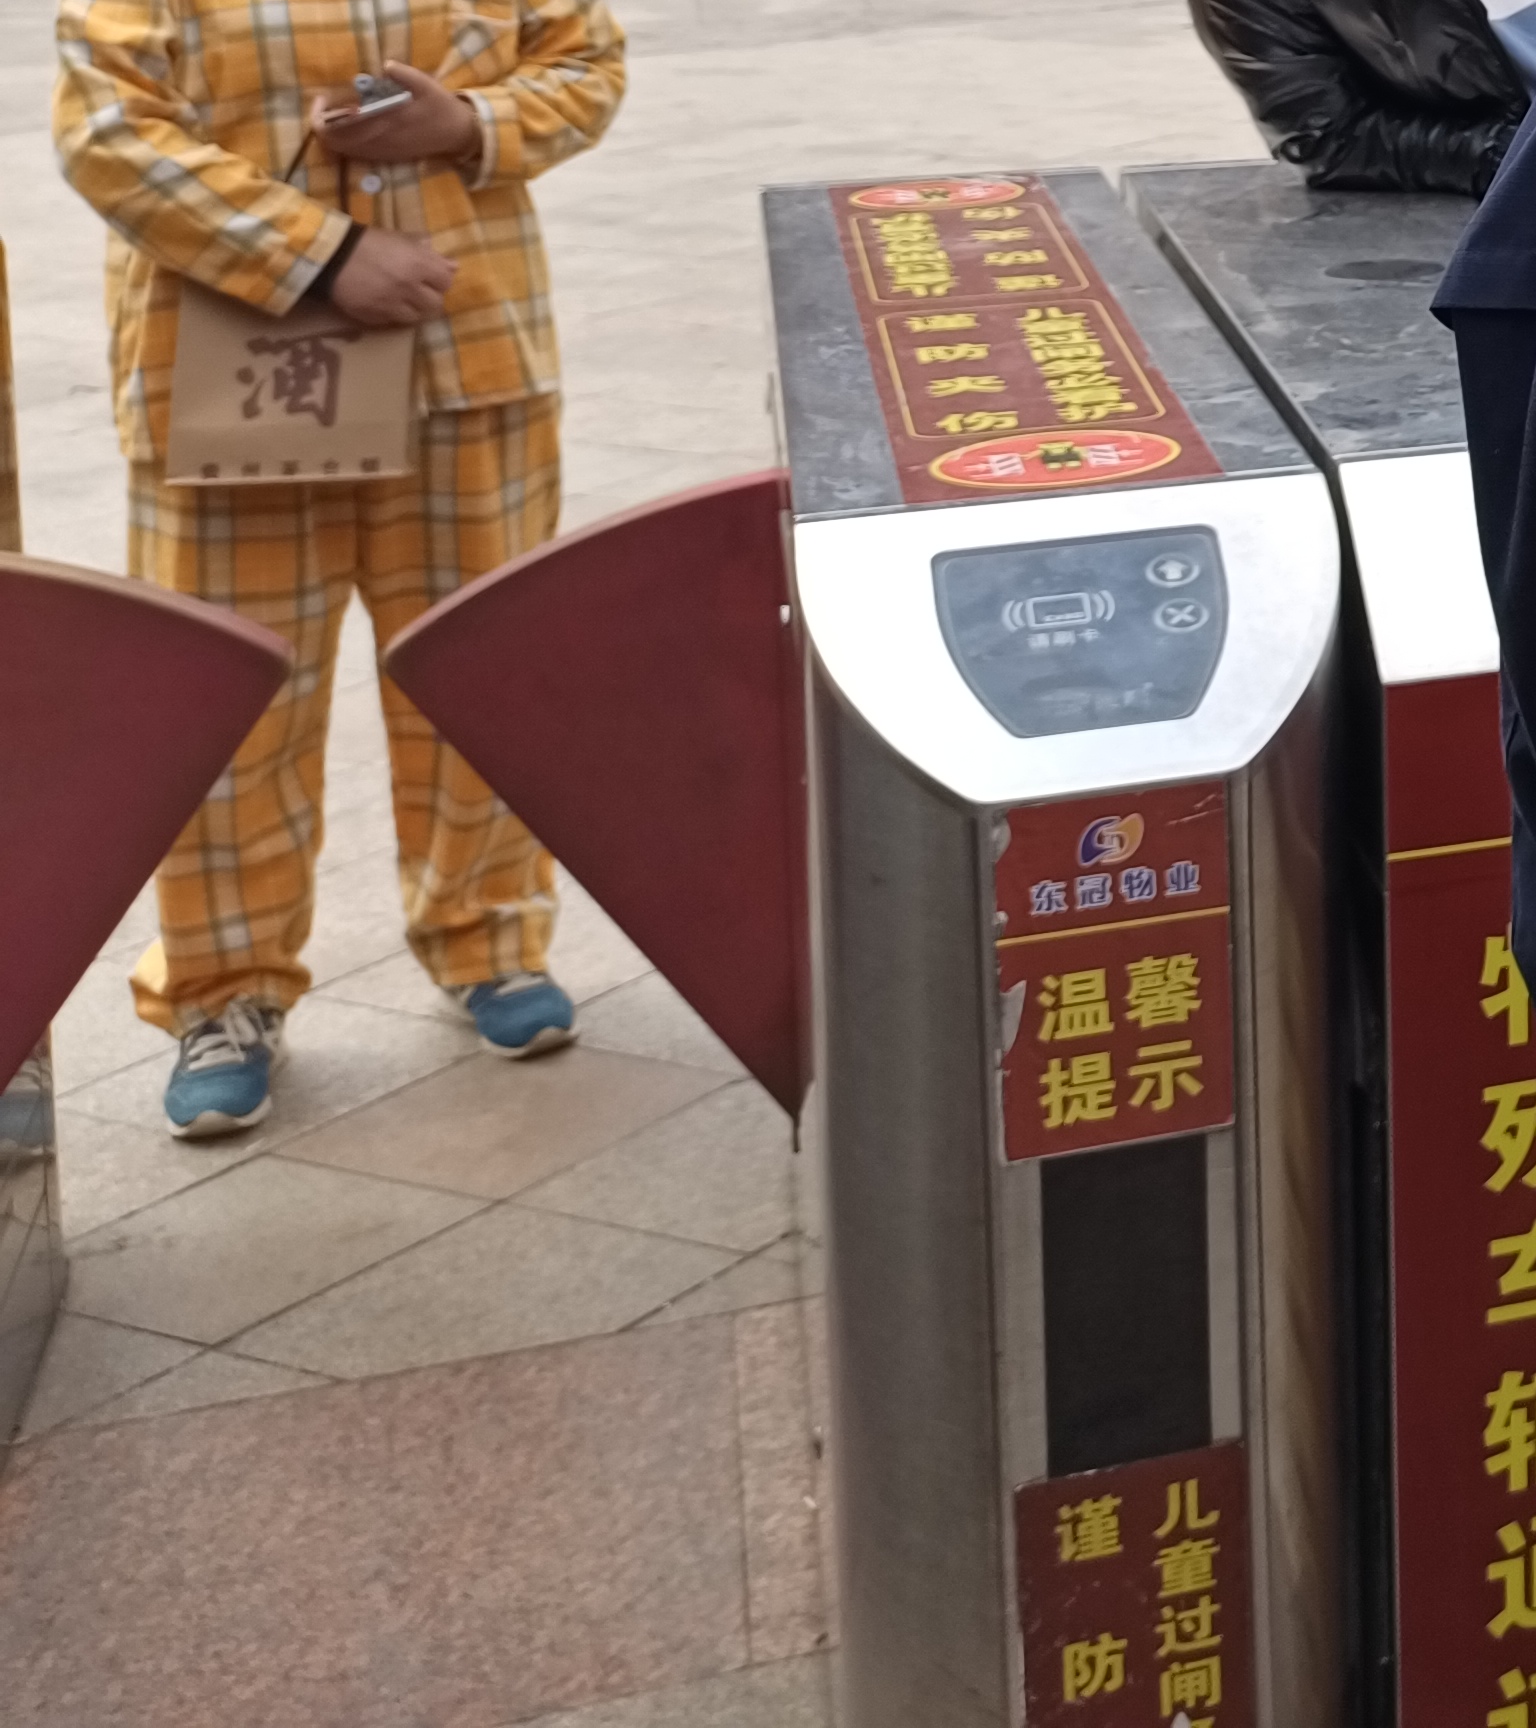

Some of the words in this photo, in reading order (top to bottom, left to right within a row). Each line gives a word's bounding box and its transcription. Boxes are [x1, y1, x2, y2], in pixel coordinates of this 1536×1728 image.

[905, 312, 1018, 433] 谨防夹伤
[1030, 860, 1201, 917] 东冠物业
[1036, 952, 1203, 1042] 温馨
[1038, 1039, 1204, 1129] 提示
[1055, 1493, 1128, 1703] 谨防
[1153, 1478, 1223, 1728] 儿童过闸
